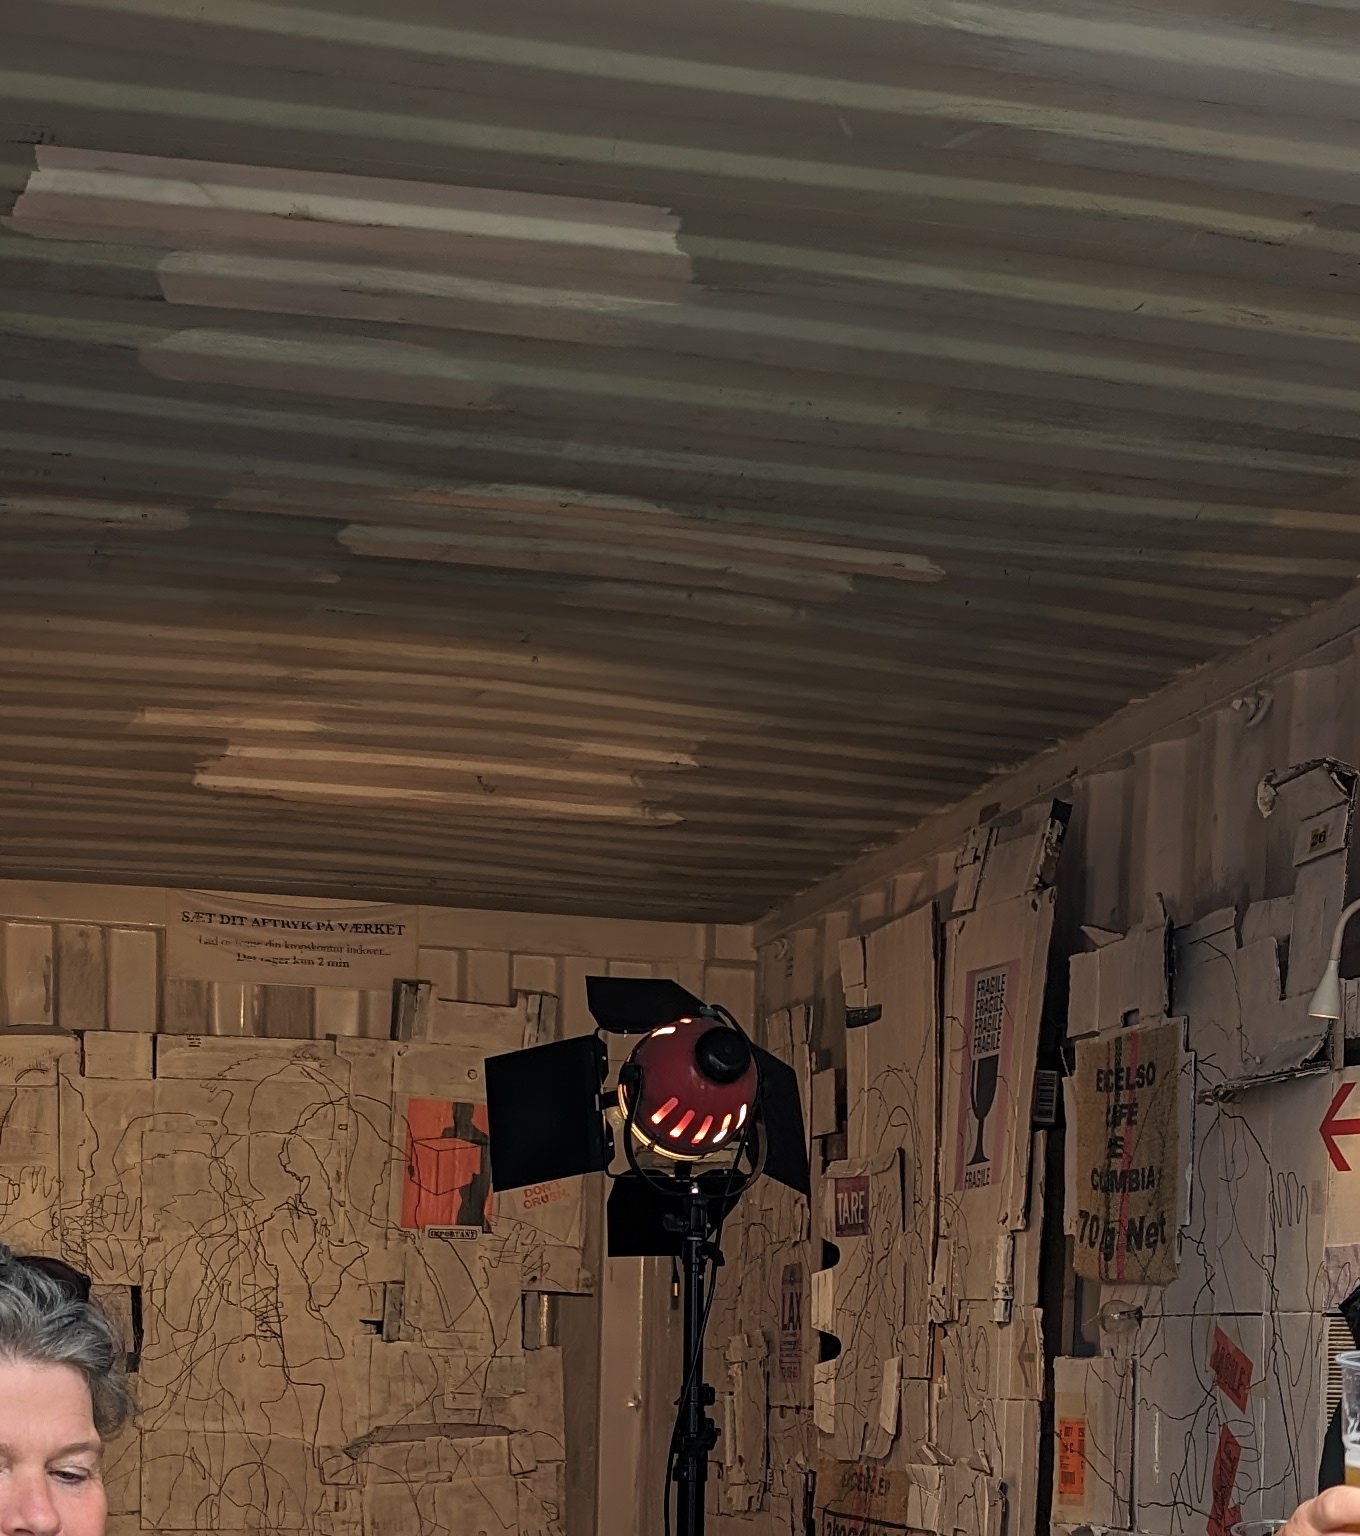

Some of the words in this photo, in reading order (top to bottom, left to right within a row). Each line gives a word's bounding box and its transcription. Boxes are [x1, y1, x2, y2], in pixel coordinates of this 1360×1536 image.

[181, 911, 216, 924] SÆT
[220, 914, 248, 926] DIT
[251, 917, 313, 931] AFTRYK
[316, 919, 335, 932] PÅ
[337, 922, 406, 936] VÆRKET
[317, 957, 324, 966] 2
[976, 974, 1006, 996] FRAGILE
[975, 993, 1005, 1014] FRAGILE
[974, 1012, 1003, 1036] FRAGILE
[973, 1031, 1000, 1055] FRAGILE
[965, 1167, 990, 1190] FRAGILE
[837, 1191, 865, 1225] TARE
[430, 1229, 476, 1239] IMPORTANT
[1126, 1211, 1166, 1252] Net
